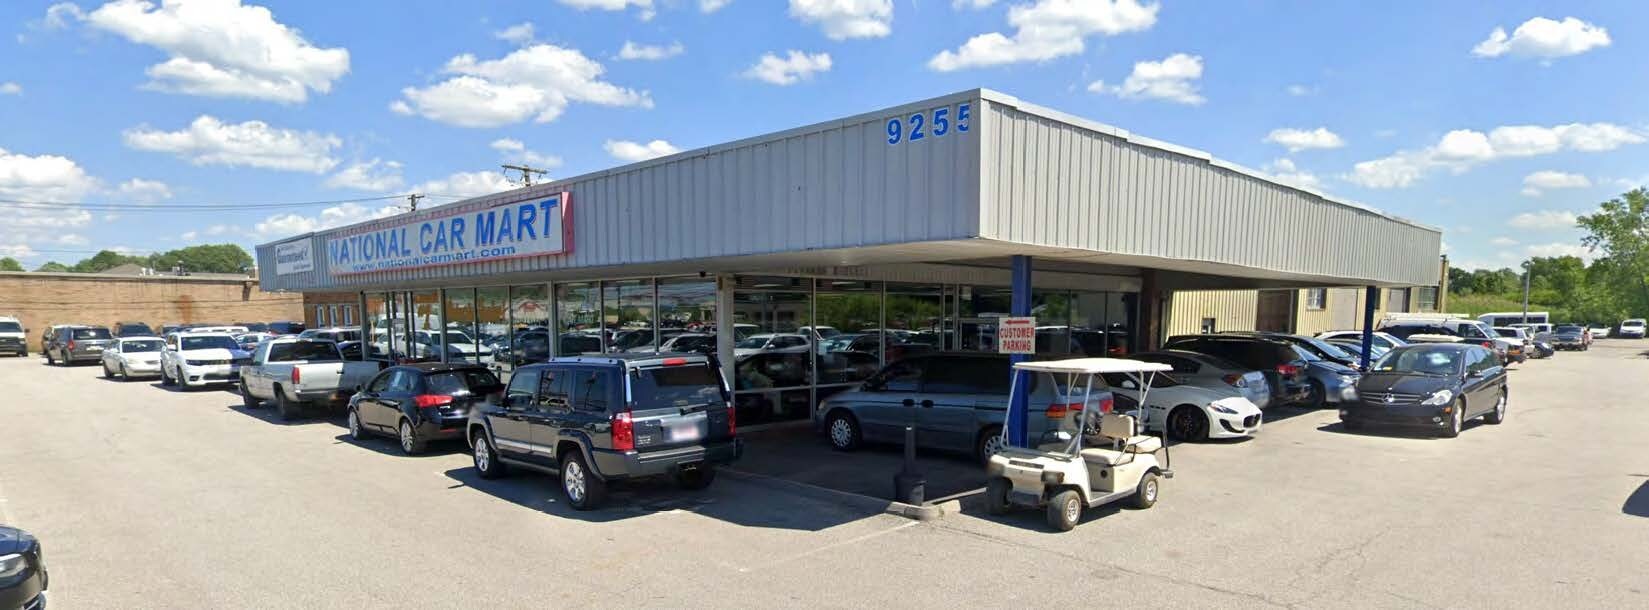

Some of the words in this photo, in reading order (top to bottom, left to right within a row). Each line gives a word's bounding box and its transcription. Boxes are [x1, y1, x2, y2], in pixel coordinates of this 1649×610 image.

[887, 104, 970, 144] 9255
[329, 227, 411, 266] NATIONAL
[420, 218, 465, 254] CAR
[475, 199, 558, 247] MART
[352, 246, 516, 271] www.nationalcarmart.com
[1000, 327, 1035, 338] CUSTOMER
[1003, 340, 1031, 351] PARKING
